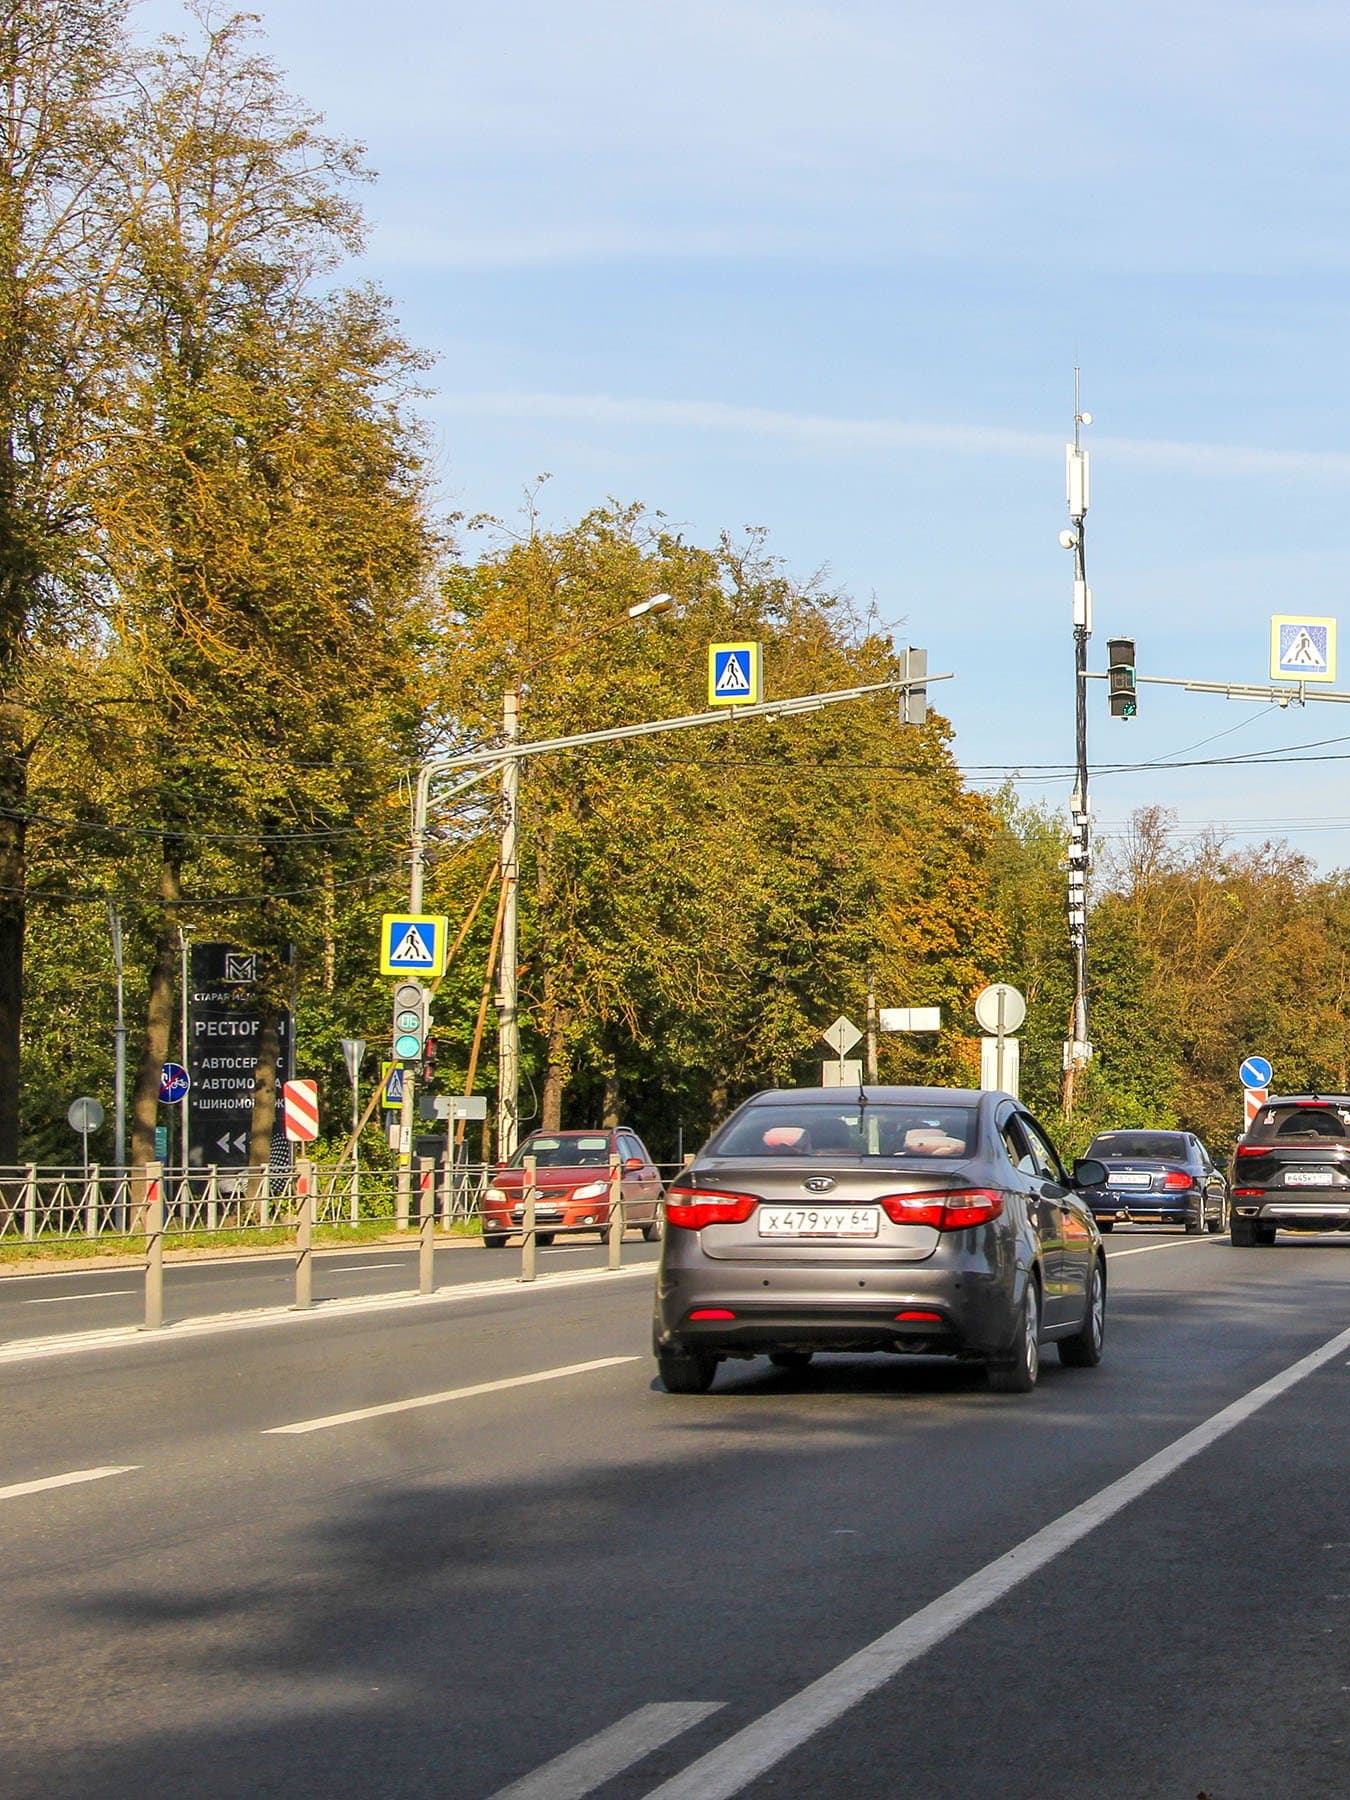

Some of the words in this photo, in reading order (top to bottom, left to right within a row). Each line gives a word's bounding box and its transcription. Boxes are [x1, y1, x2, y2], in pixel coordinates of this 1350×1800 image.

[195, 1021, 285, 1036] РЕСТОРН
[201, 1057, 283, 1069] АВТОСЕРС
[202, 1078, 281, 1090] АВТОМОА
[850, 1211, 869, 1225] 64
